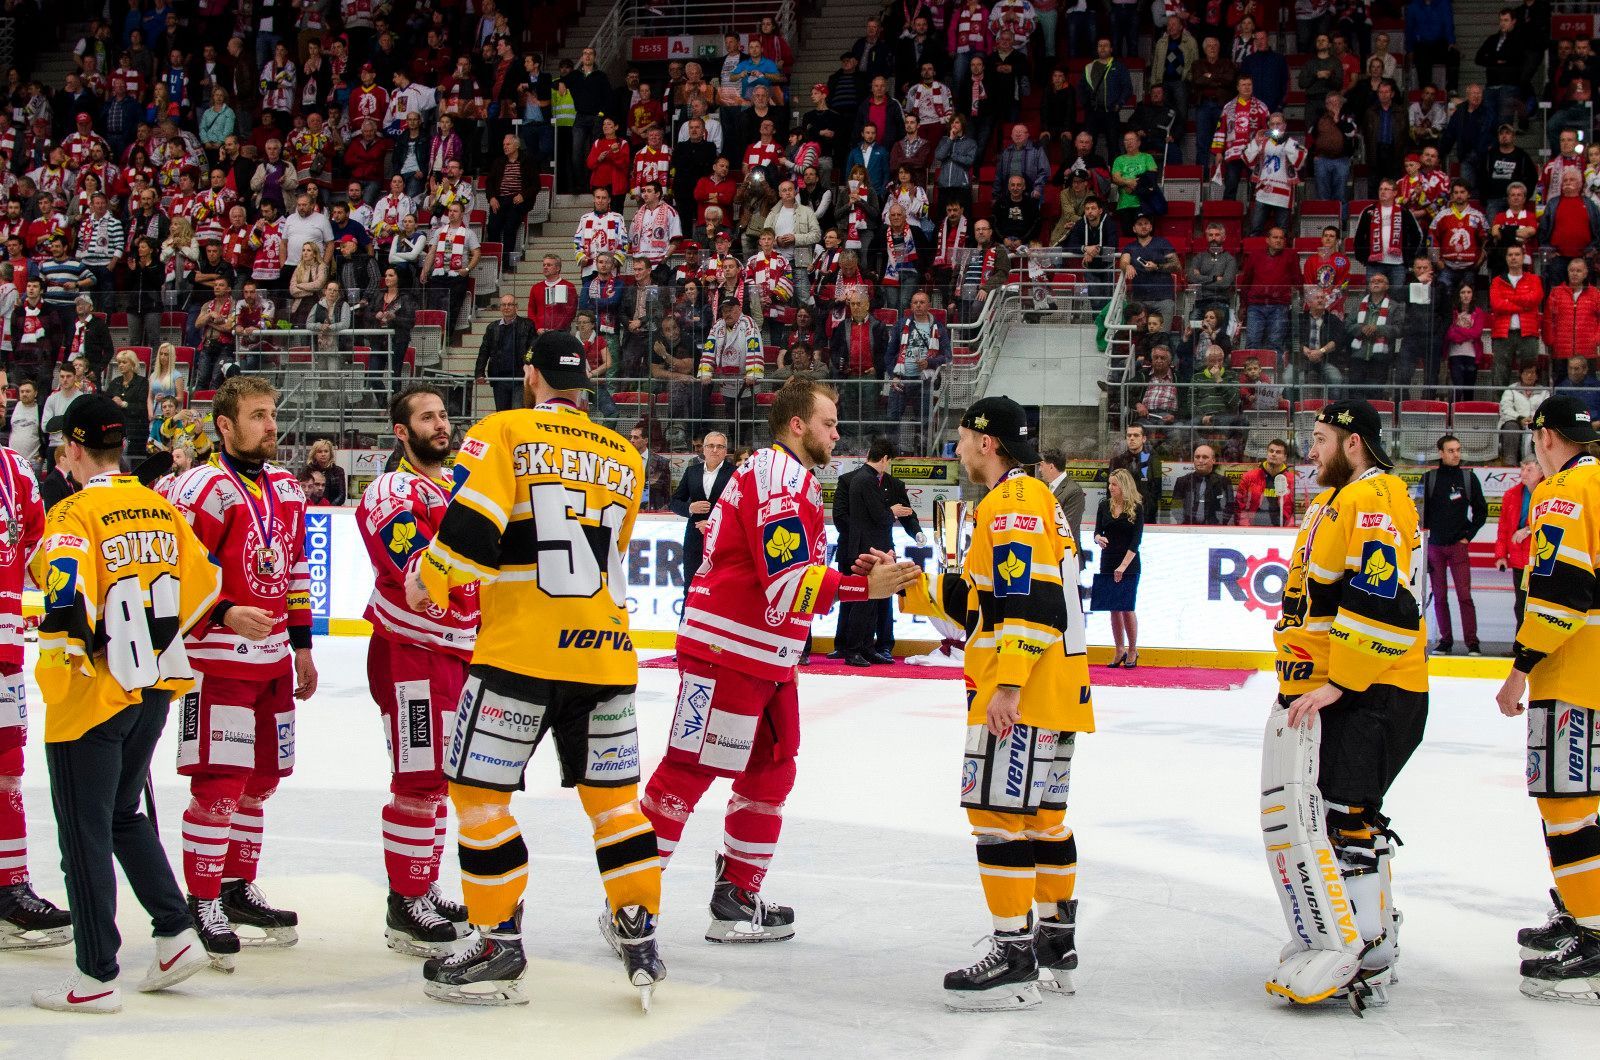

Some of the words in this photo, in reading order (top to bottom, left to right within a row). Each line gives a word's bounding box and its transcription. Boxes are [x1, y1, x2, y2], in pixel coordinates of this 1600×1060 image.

[536, 422, 627, 454] PETROTRANS
[912, 468, 933, 477] PLAY
[1076, 470, 1097, 478] PLAY
[101, 508, 173, 526] PETROTRANS
[1550, 499, 1576, 516] AVE
[1013, 515, 1038, 531] AVE
[1361, 513, 1384, 528] AVE
[58, 535, 83, 548] AVE
[308, 515, 328, 616] Reebok
[558, 629, 632, 652] verva
[189, 698, 198, 739] BANDI
[416, 704, 428, 743] BANDI
[480, 714, 538, 733] SYSTEMS
[482, 704, 540, 728] uniCODE
[449, 688, 474, 769] verva
[1568, 708, 1585, 783] verva
[1005, 724, 1028, 798] verva
[1296, 861, 1327, 936] VAUGHN
[1315, 848, 1358, 944] VAUGHN
